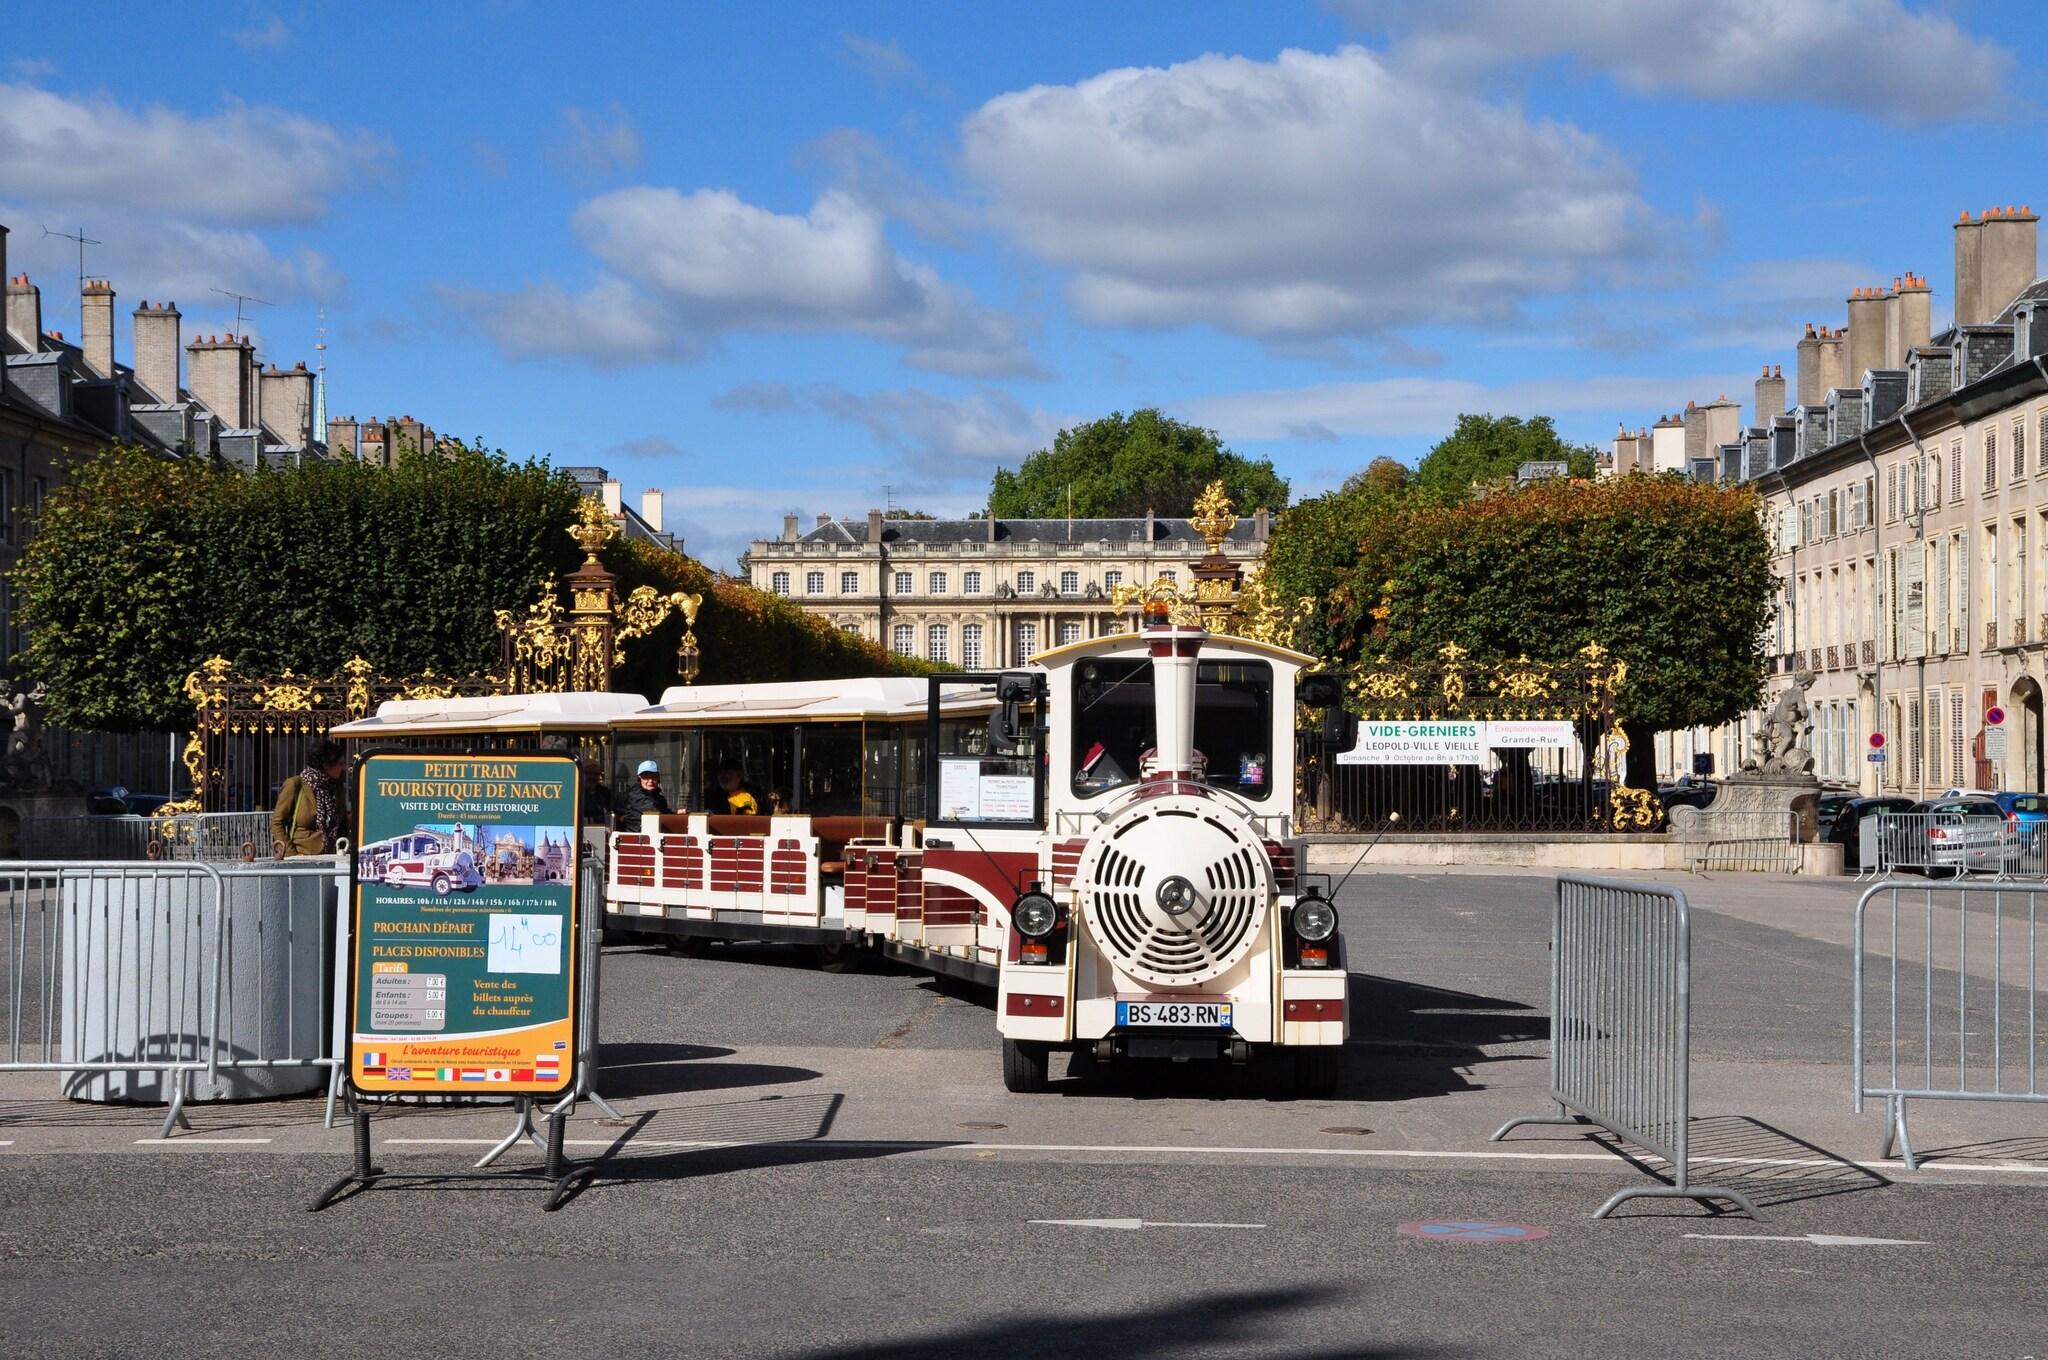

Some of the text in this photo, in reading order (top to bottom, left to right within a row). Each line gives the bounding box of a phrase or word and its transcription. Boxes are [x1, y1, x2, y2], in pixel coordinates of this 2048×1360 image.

[1368, 725, 1477, 737] VIDE-GRENIERS
[1366, 741, 1480, 751] LEOPOLD-VILLE VIEILLE
[1501, 736, 1558, 744] Grande-Rue
[424, 763, 518, 779] PETIT TRAIN
[378, 781, 563, 801] TOURISTIQUE DE NANCY
[400, 802, 540, 814] VISITE DU CENTRE HISTORIQUE
[376, 897, 416, 905] HORAIRES:
[373, 920, 475, 934] PROCHAIN DÉPART
[372, 946, 485, 958] PLACES DISPONIBLES
[377, 963, 404, 974] Tarifs
[473, 980, 517, 989] Vente des
[473, 993, 534, 1005] billets auprès
[473, 1006, 531, 1016] du chauffeur
[1129, 1005, 1218, 1023] BS-483-RN
[1221, 1017, 1231, 1025] 54
[402, 1044, 521, 1059] L'aventure touristique
